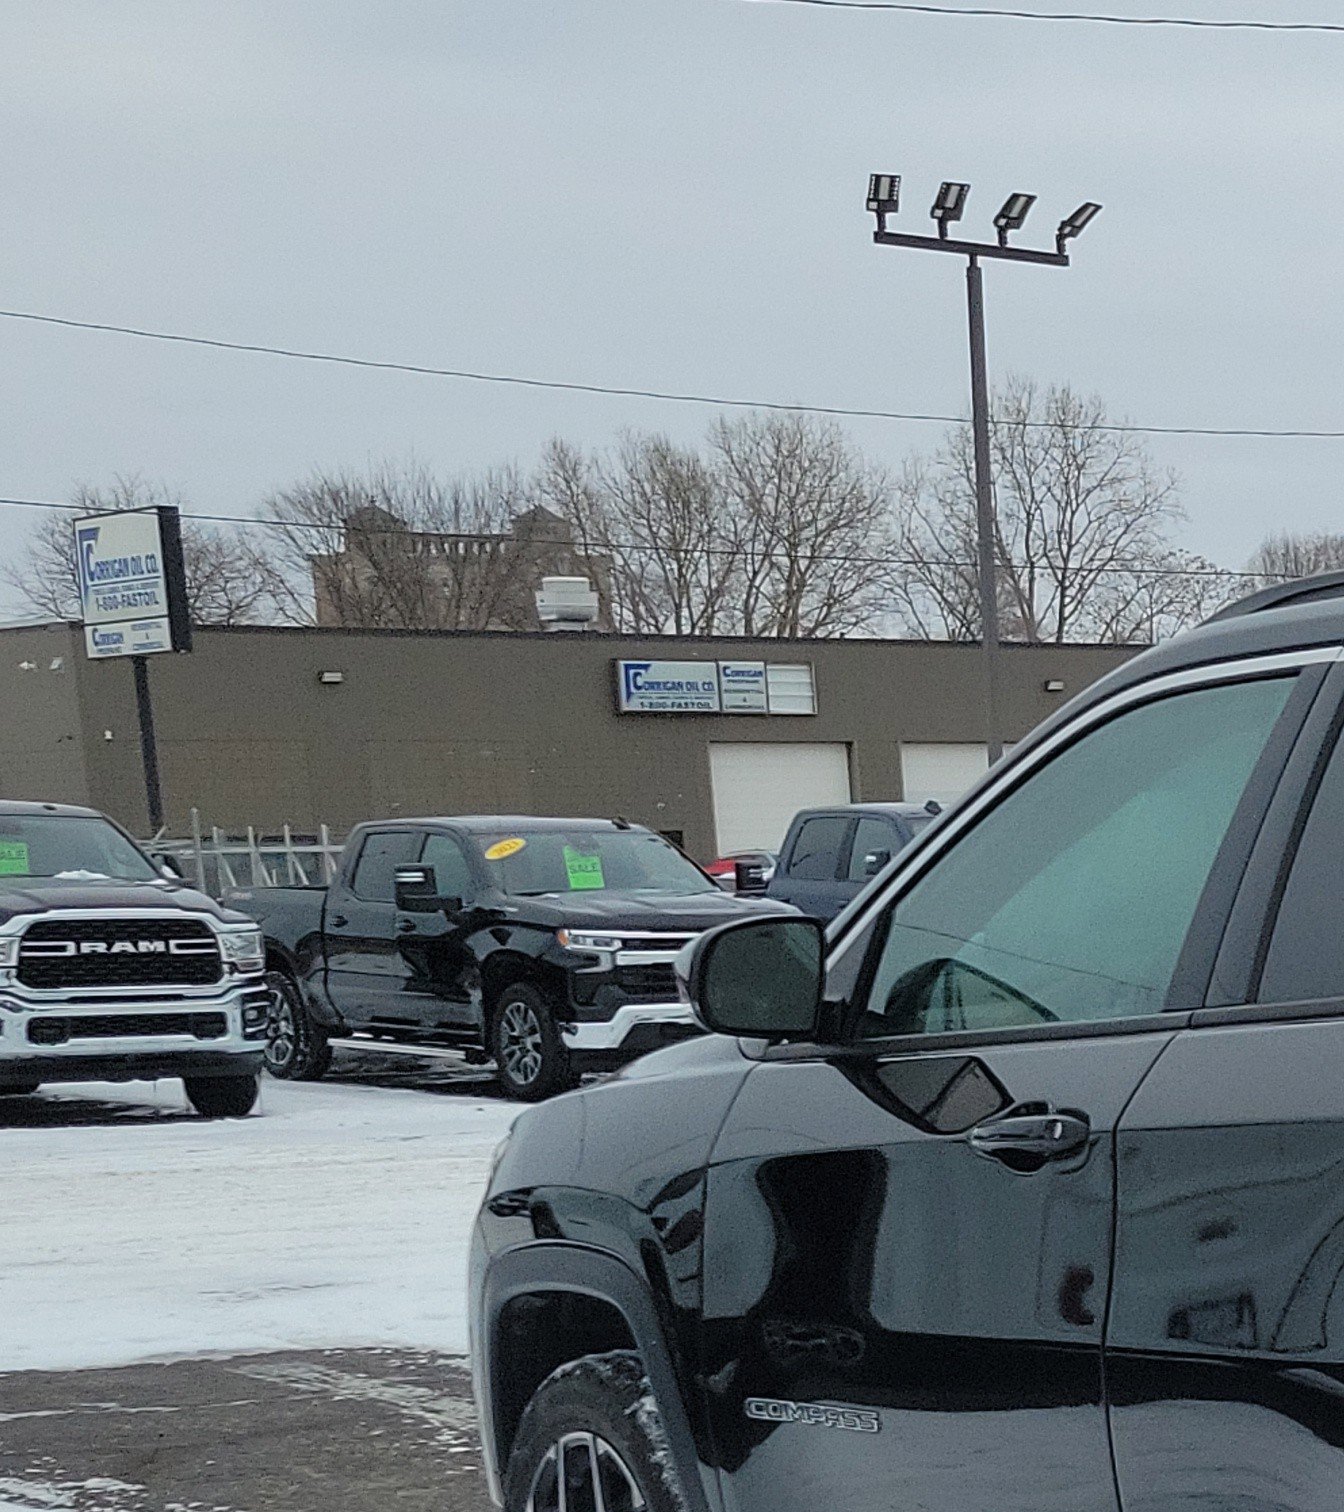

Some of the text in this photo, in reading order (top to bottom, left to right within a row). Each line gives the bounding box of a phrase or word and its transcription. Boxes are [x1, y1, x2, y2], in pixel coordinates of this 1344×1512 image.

[85, 543, 130, 582] CORRIGAN
[130, 555, 145, 575] OIL
[632, 672, 683, 691] CORRIGAN
[685, 681, 700, 692] OIL
[722, 666, 764, 678] CORRIGAN
[80, 941, 167, 953] RAM
[746, 1398, 881, 1433] COMPASS
